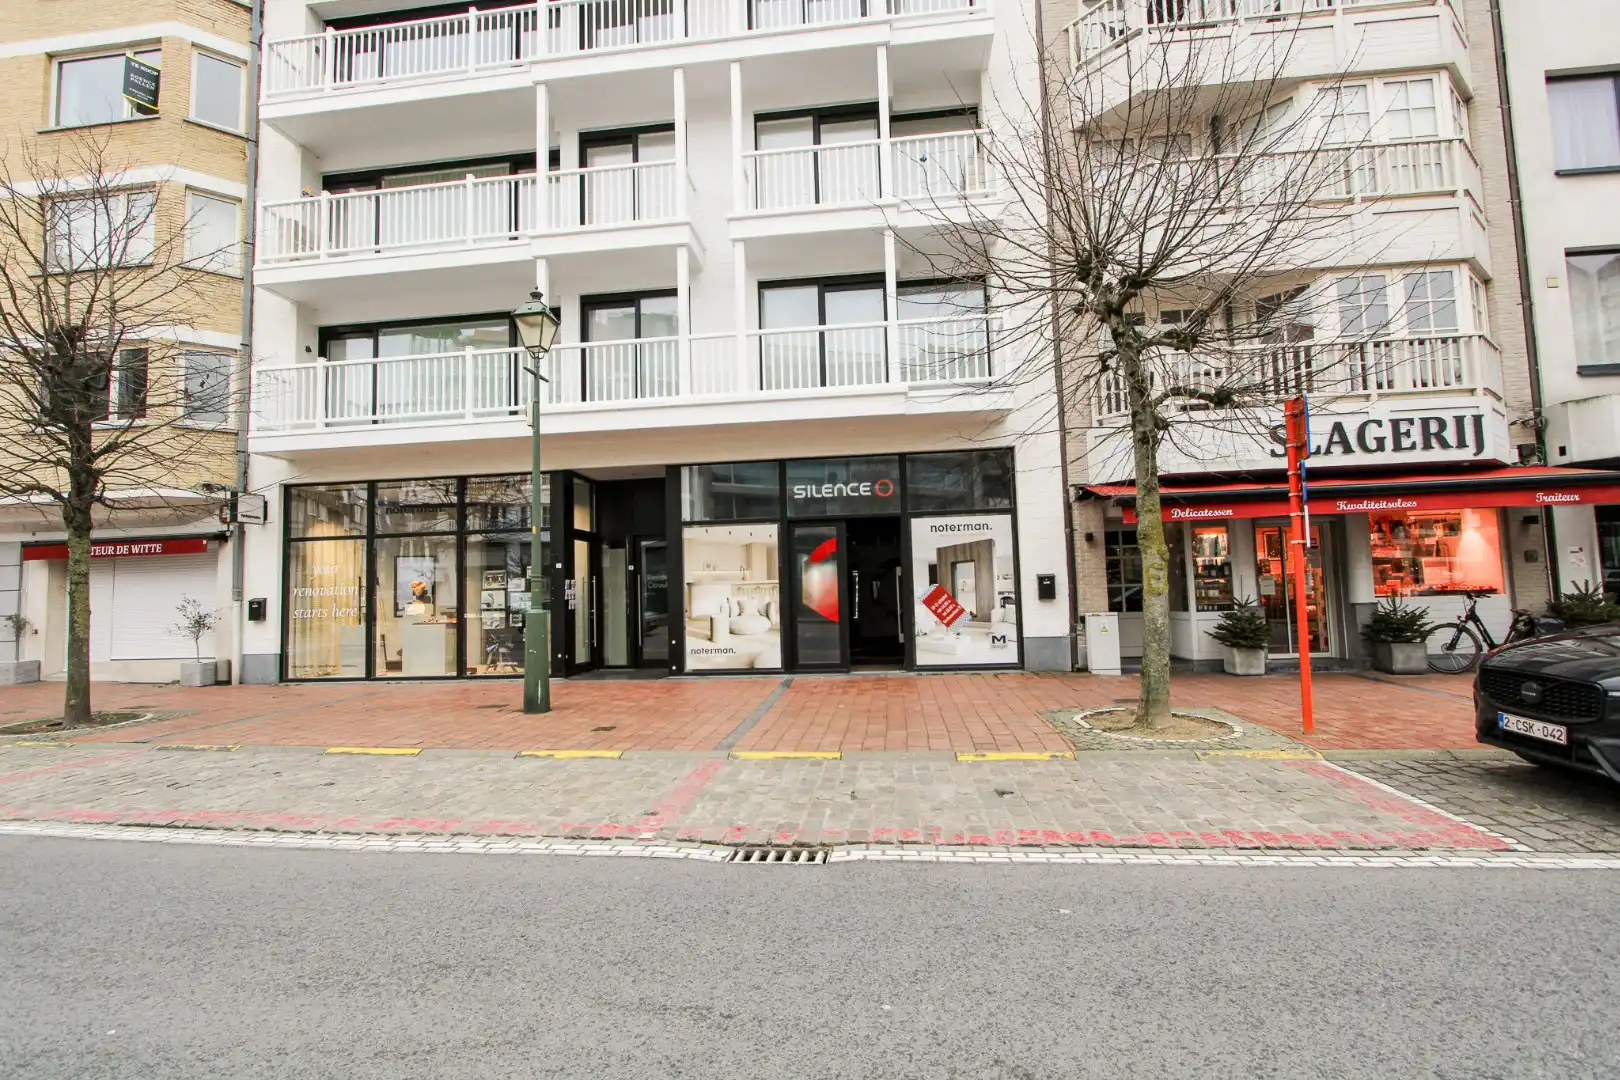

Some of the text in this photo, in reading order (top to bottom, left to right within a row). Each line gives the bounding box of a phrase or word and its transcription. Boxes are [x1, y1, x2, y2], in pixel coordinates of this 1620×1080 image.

[793, 482, 872, 499] SILENCE
[1535, 492, 1581, 503] Traiteur
[1336, 498, 1418, 511] Kwaliteitsvlees
[1171, 507, 1234, 519] Delicatessen
[930, 523, 993, 533] noterman.
[116, 545, 130, 555] DE
[131, 543, 162, 554] WITTE
[293, 583, 358, 597] renovation
[293, 602, 358, 619] starts here
[690, 647, 737, 655] noterman.
[1504, 716, 1564, 741] 2-CSK-042
